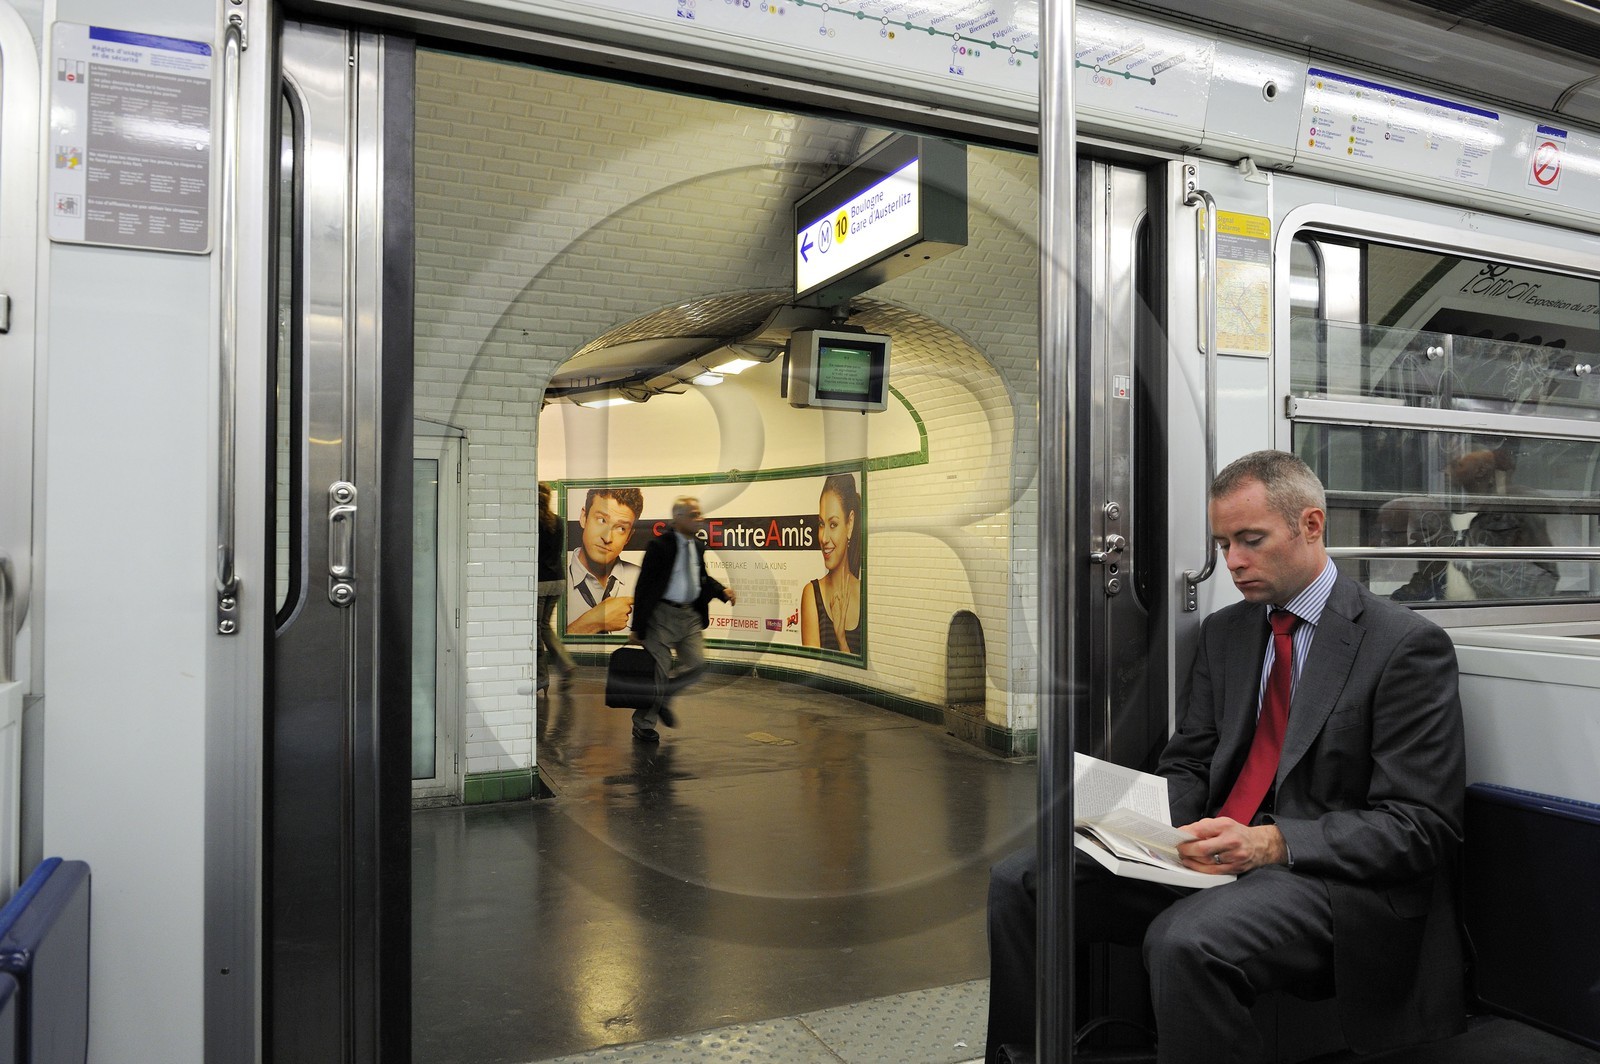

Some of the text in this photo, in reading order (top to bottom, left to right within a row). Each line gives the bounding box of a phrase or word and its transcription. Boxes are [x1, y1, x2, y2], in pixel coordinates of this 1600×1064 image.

[907, 8, 930, 20] Rennes
[92, 44, 142, 57] Règles d'usage
[112, 54, 138, 63] sécurité
[1096, 52, 1111, 63] Porte
[836, 216, 848, 238] 10
[851, 190, 884, 218] Boulogne
[851, 192, 911, 235] Gare d'Austerlitz
[1526, 295, 1571, 310] Exposition
[1570, 302, 1582, 311] du
[1582, 304, 1597, 313] 27
[710, 561, 747, 570] TIMBERLAKE
[754, 562, 769, 570] MILA
[770, 562, 787, 570] KUNIS
[716, 617, 758, 630] SEPTEMBRE
